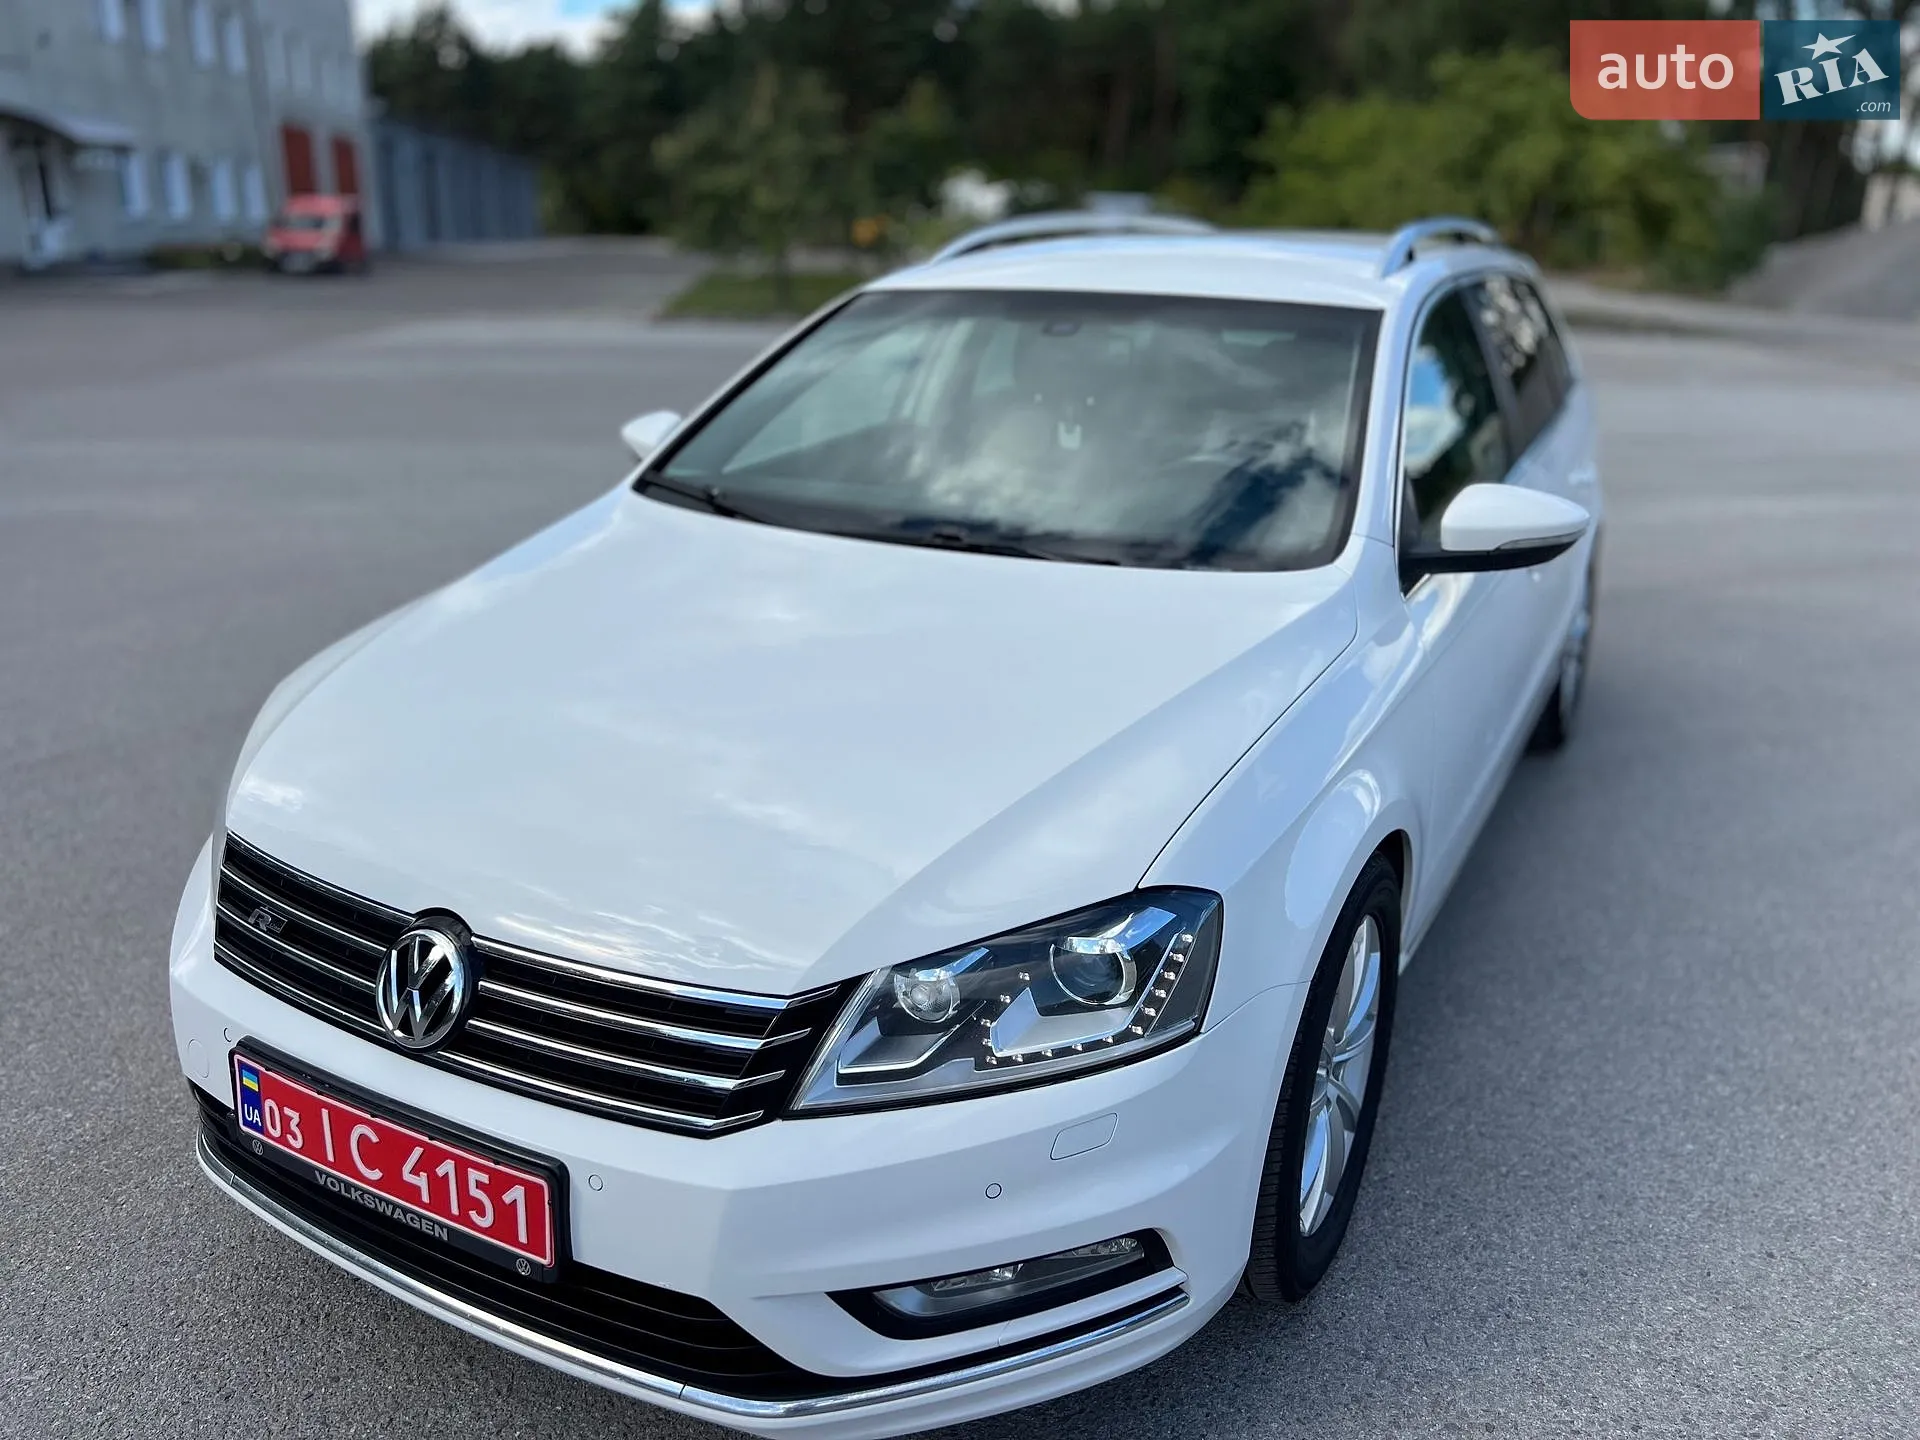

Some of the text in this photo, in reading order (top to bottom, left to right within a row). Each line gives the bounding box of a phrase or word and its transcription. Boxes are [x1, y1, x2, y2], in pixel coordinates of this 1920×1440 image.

[244, 1104, 262, 1127] UA
[264, 1098, 528, 1244] 03 IC 4151
[314, 1169, 449, 1241] VOLKSWAGEN
